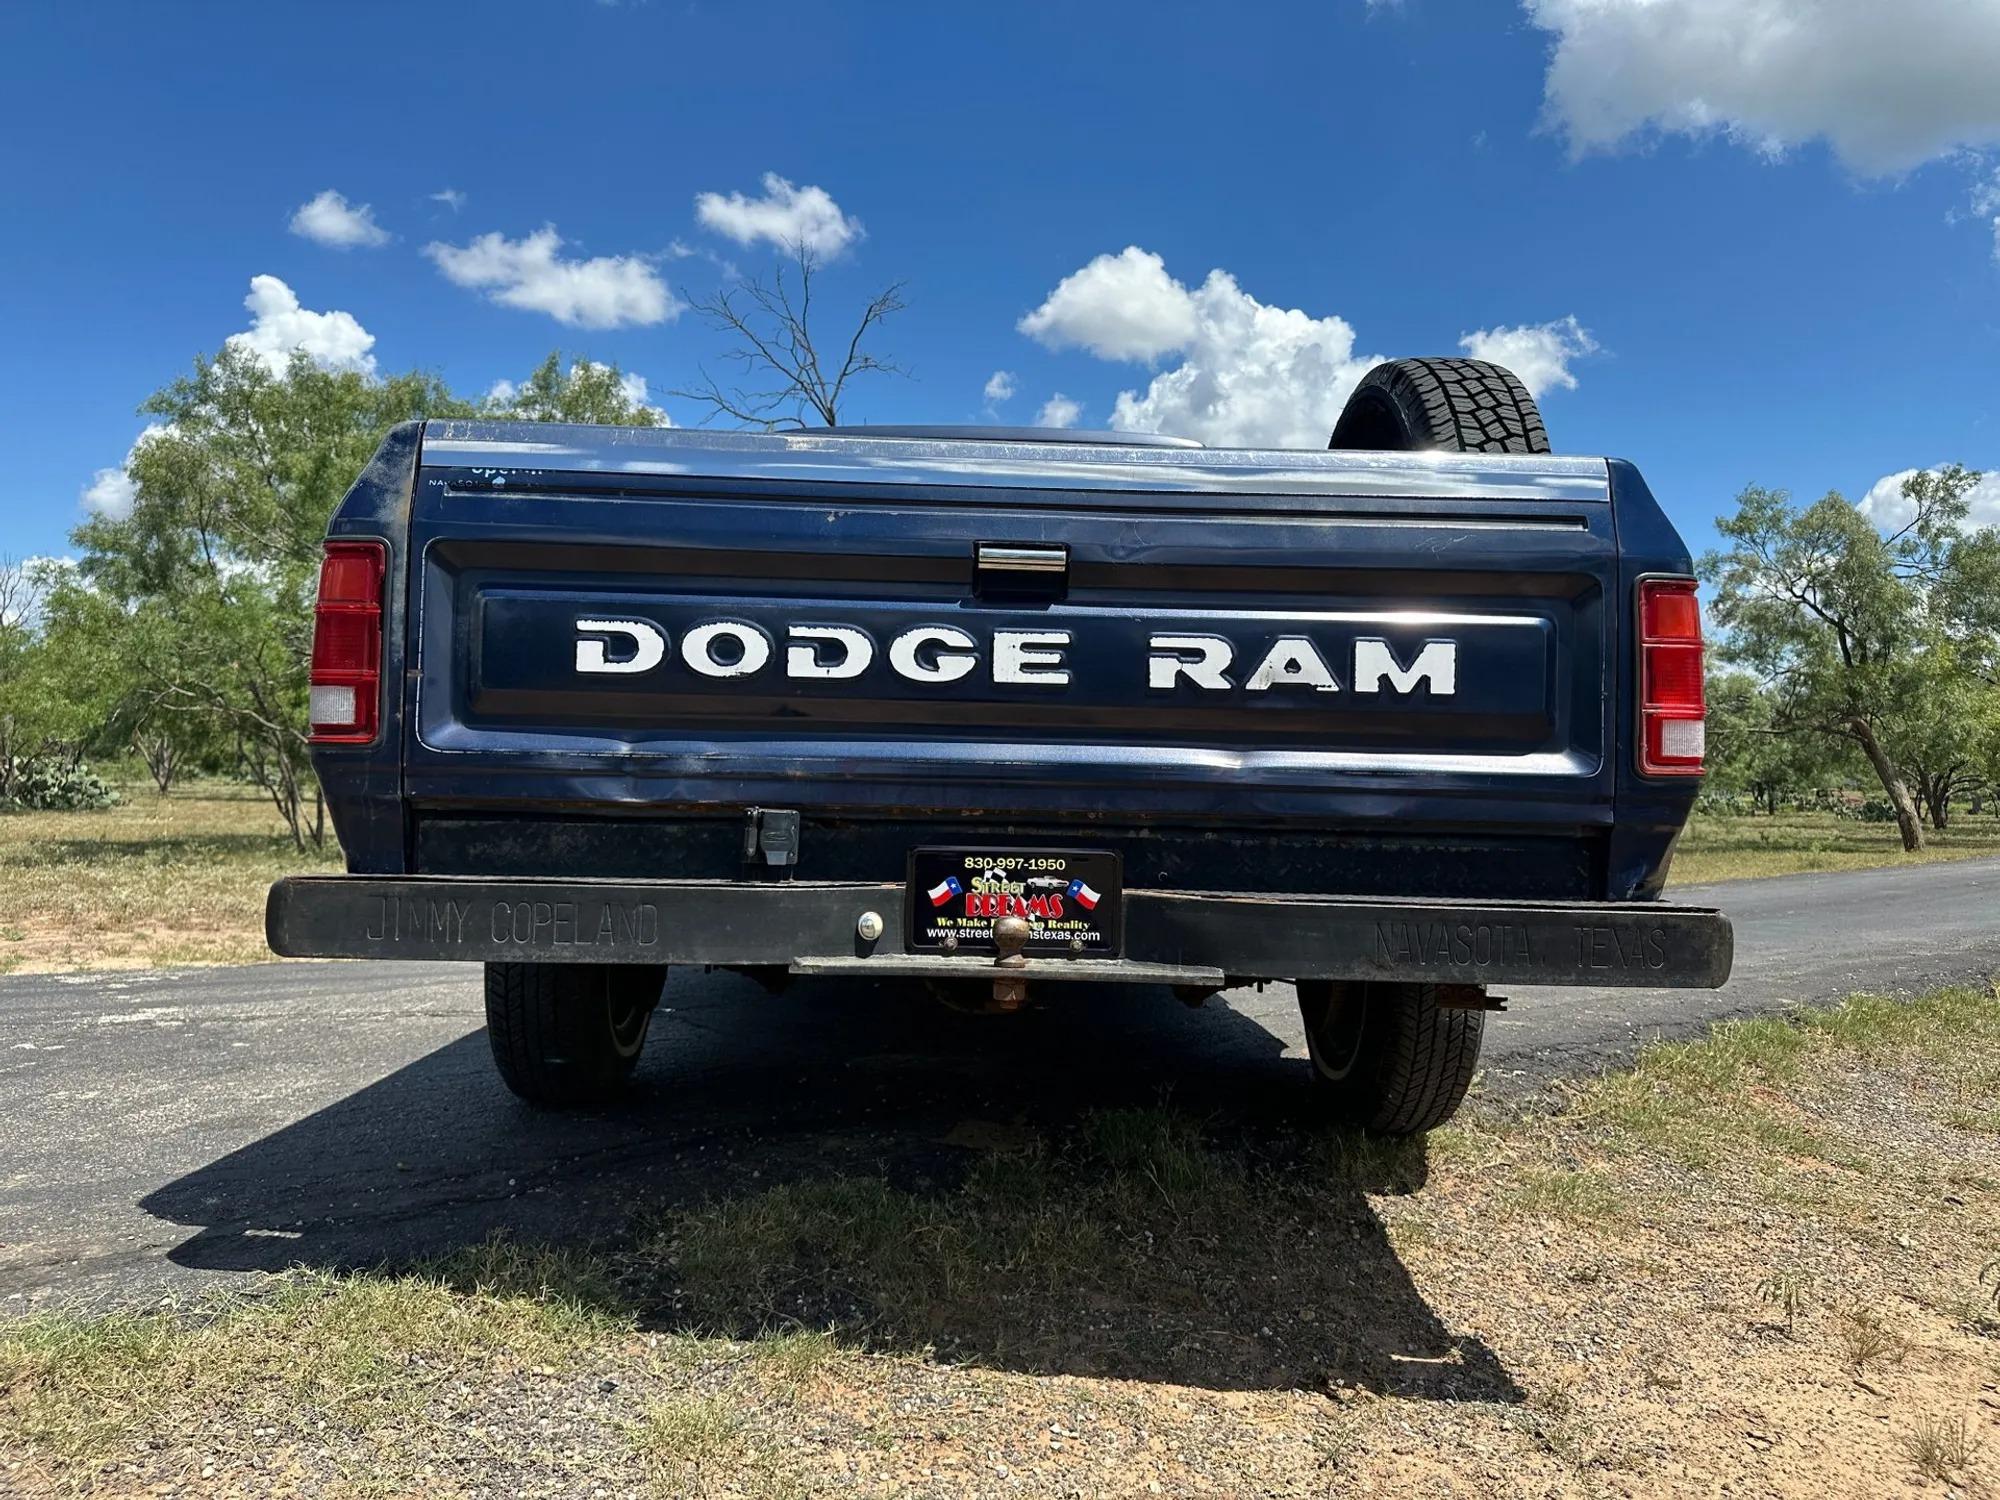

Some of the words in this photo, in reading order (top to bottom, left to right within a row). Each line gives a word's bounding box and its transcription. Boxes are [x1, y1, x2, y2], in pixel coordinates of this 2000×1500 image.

[575, 618, 1072, 685] DODGE
[1148, 635, 1458, 695] RAM
[964, 857, 1066, 871] 830-997-1950
[965, 892, 1064, 919] DREAMS
[366, 895, 474, 943] JIMMY
[491, 901, 659, 946] COPELAND
[927, 927, 1101, 941] www.streetstexas.com
[937, 917, 954, 928] We
[957, 917, 988, 928] Make
[1048, 919, 1091, 931] Reality
[1573, 925, 1667, 969] TEXAS
